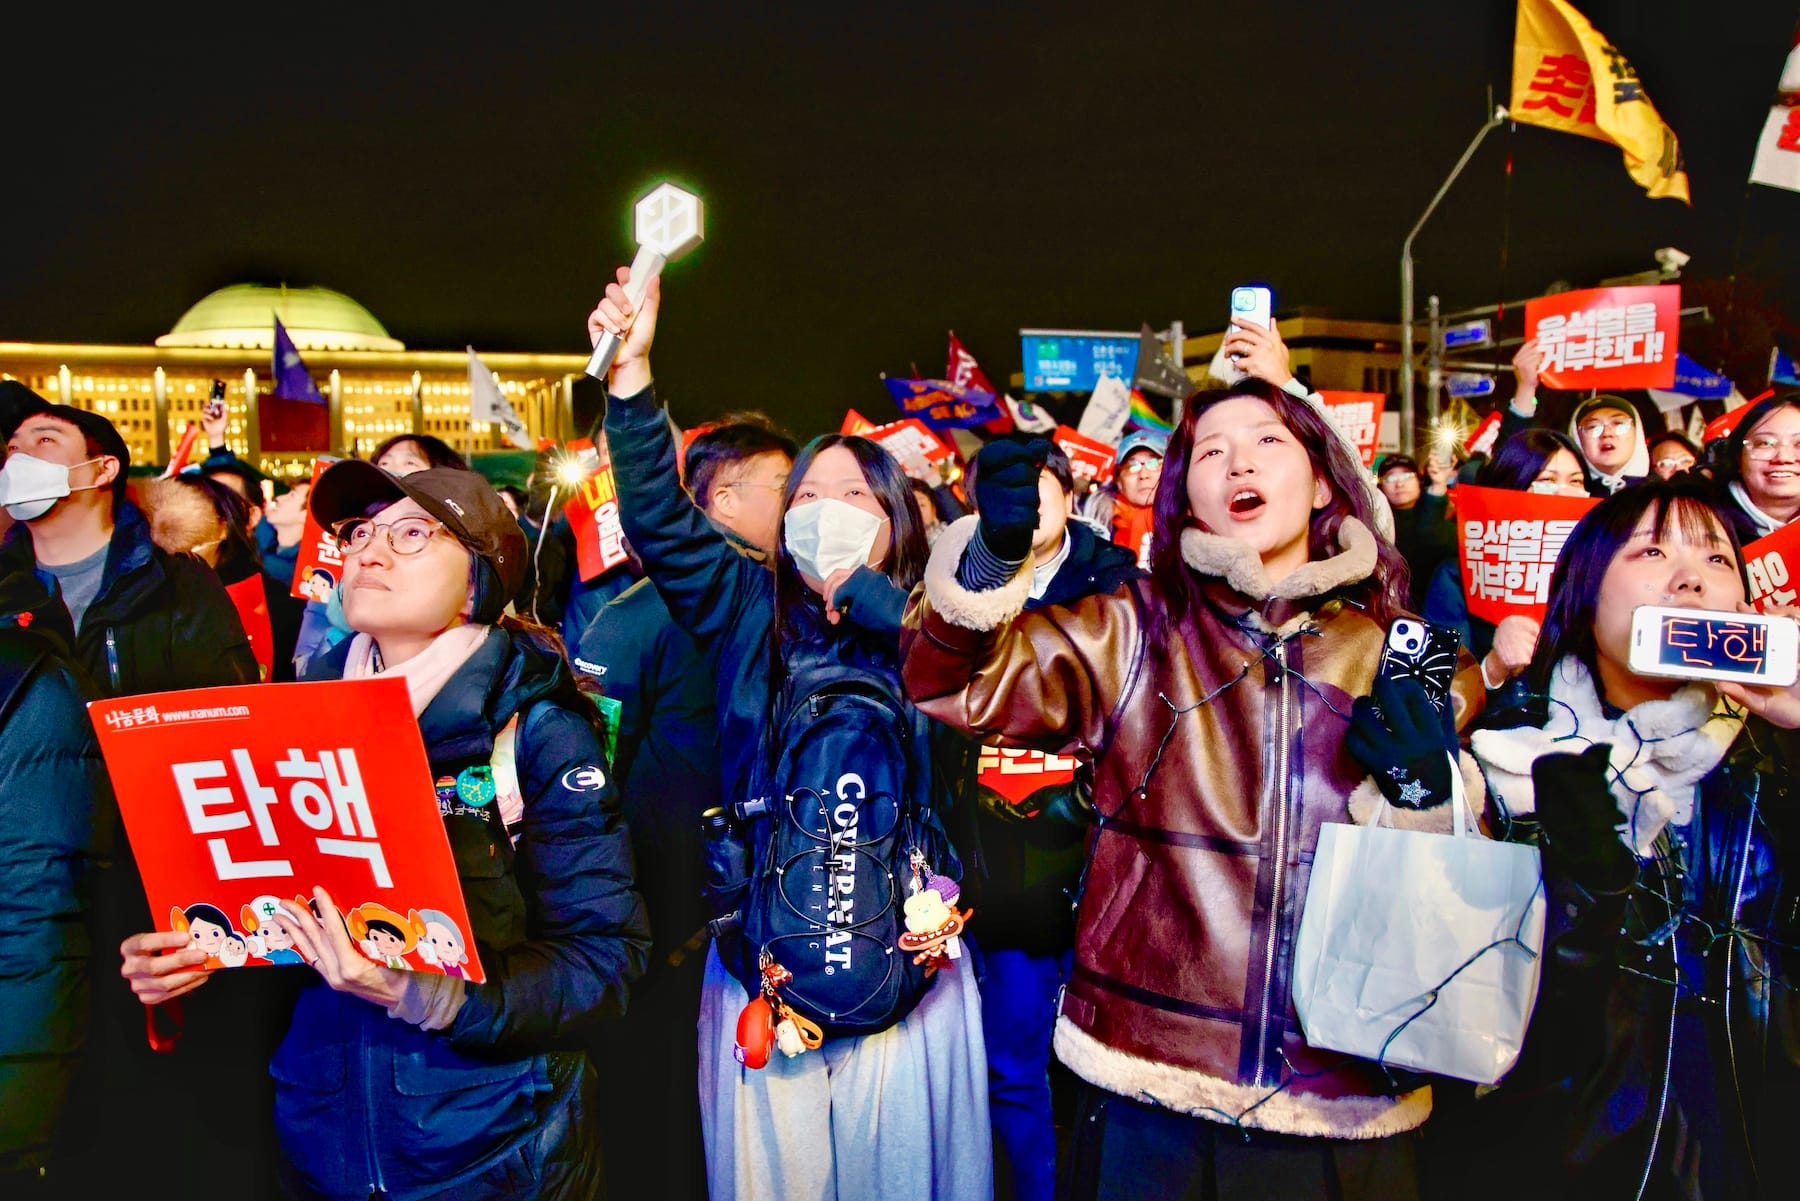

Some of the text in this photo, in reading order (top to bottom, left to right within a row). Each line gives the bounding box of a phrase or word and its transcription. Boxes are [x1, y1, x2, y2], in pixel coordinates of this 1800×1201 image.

[1536, 302, 1657, 345] 윤석열을
[1536, 331, 1665, 374] 거부한다!
[1664, 618, 1765, 674] 탄핵
[104, 705, 250, 728] 나눔문화 www.nanum.com
[171, 748, 394, 888] 탄핵
